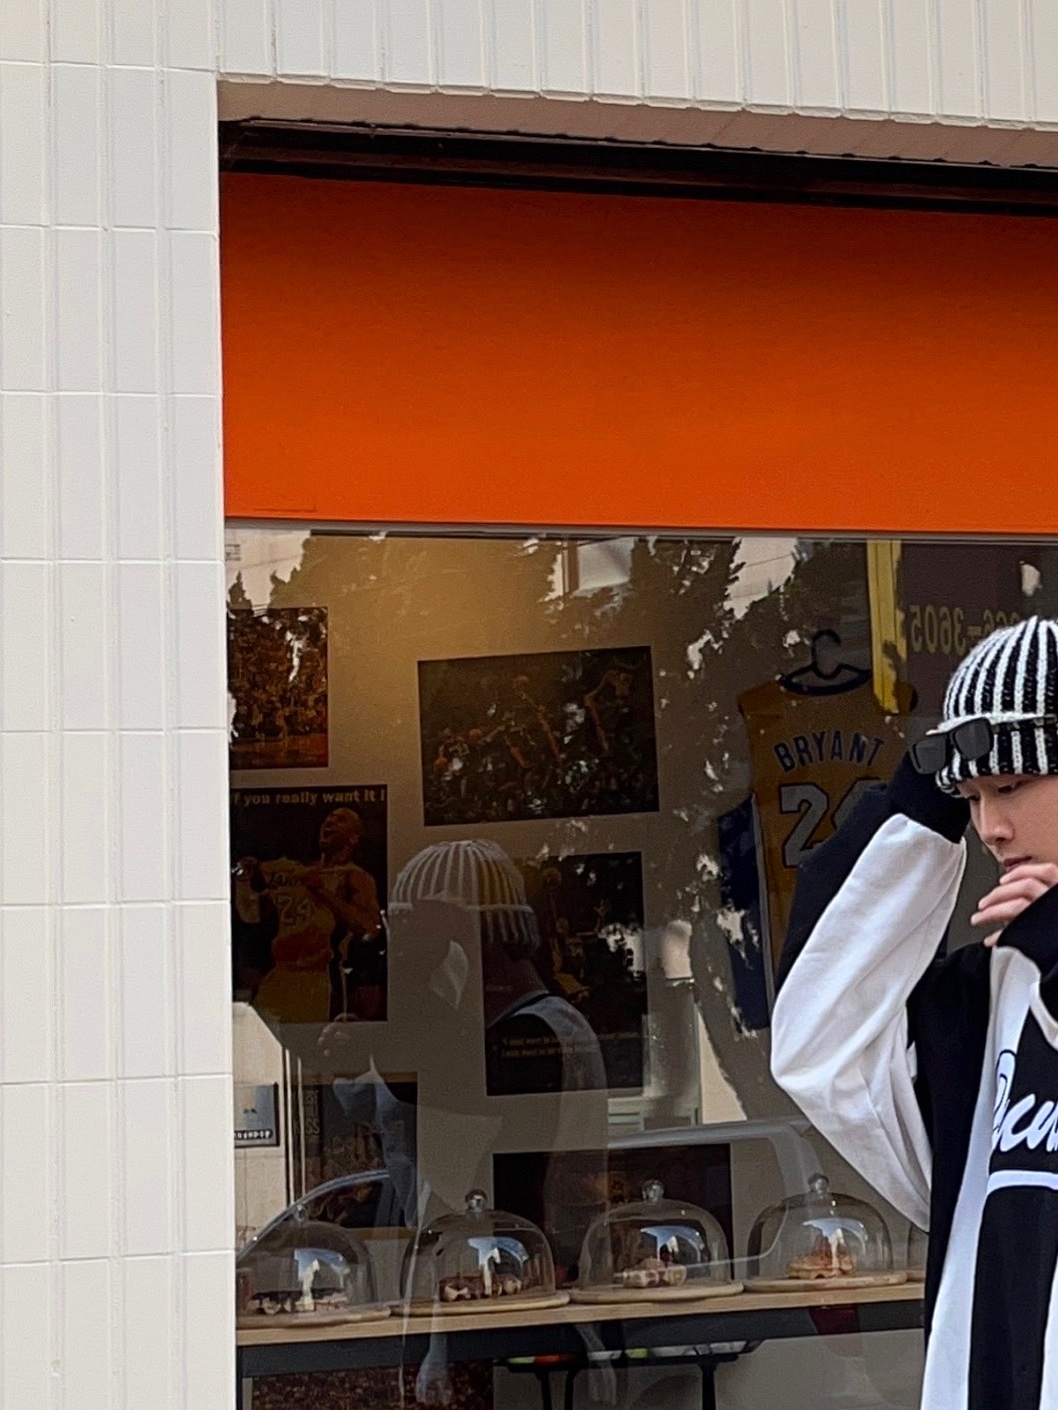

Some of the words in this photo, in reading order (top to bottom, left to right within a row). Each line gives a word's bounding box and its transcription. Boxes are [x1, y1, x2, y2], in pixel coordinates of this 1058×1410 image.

[773, 730, 884, 773] BRYANT
[243, 794, 271, 807] you
[275, 790, 318, 806] really
[322, 790, 360, 803] want
